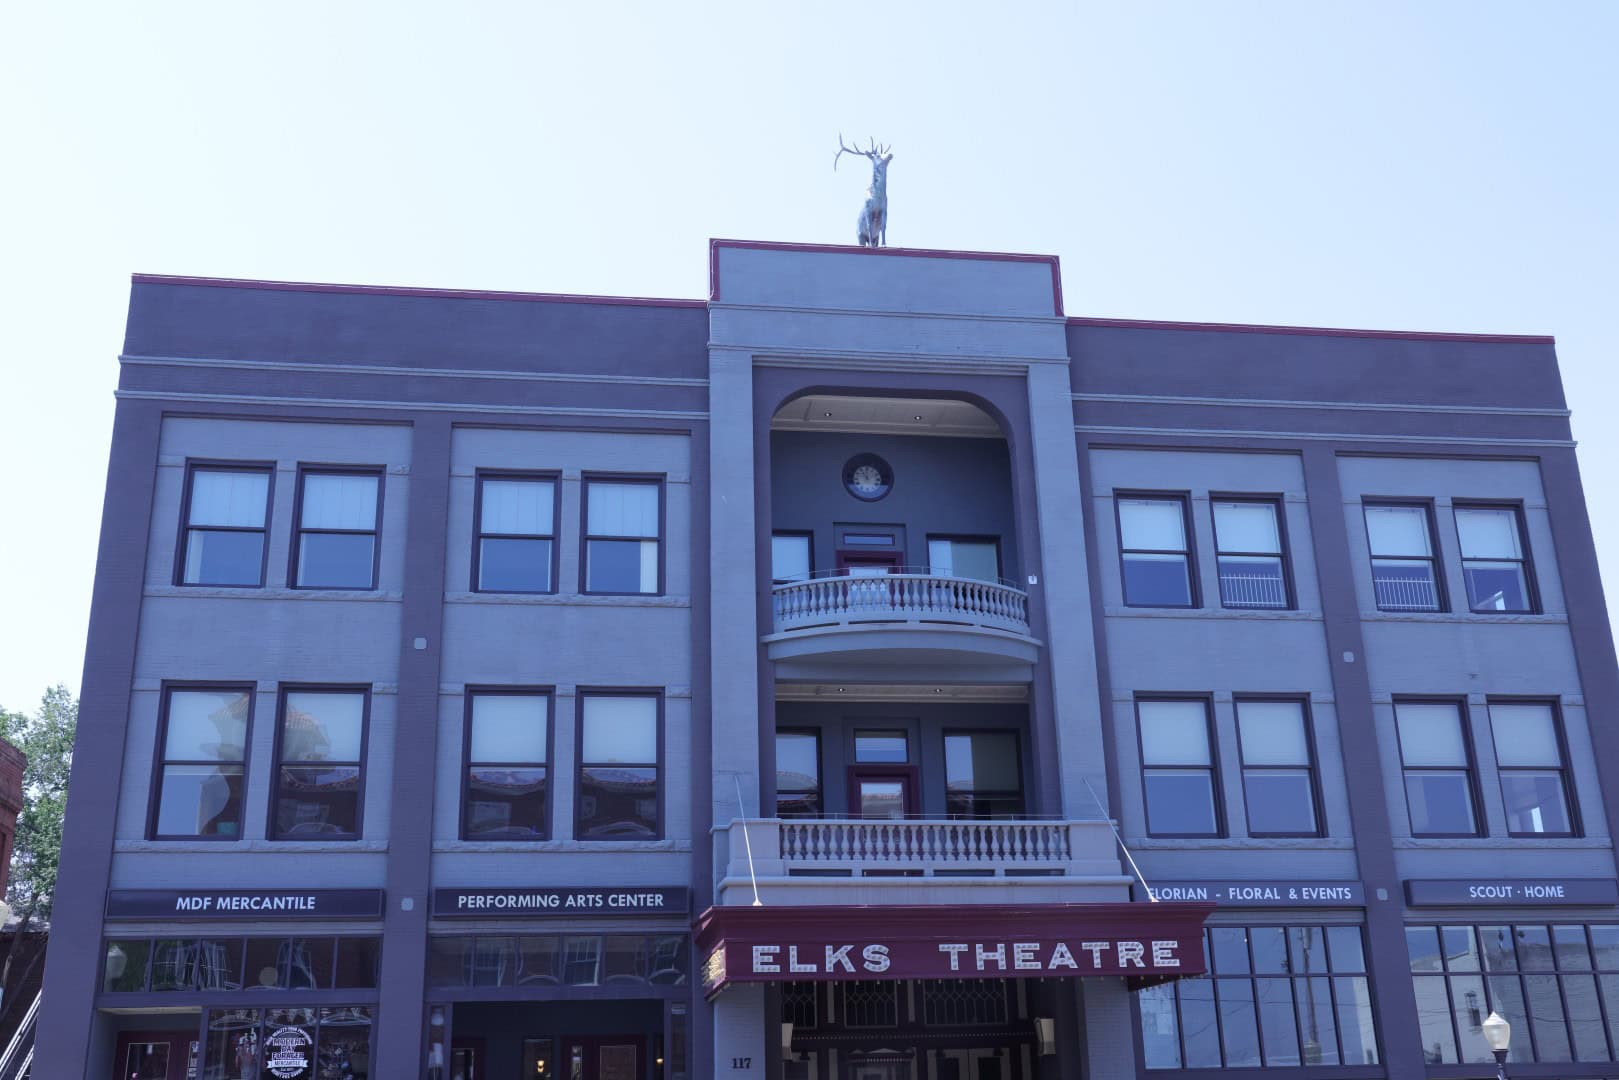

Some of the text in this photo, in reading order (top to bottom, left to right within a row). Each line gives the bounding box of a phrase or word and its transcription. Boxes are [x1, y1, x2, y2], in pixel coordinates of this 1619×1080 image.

[1228, 887, 1281, 900] FLORAL
[1288, 887, 1298, 900] &
[1302, 887, 1352, 900] EVENTS
[1469, 886, 1513, 899] SCOUT
[1524, 886, 1565, 898] HOME
[176, 896, 316, 911] MDF MERCANTILE
[457, 893, 664, 909] PERFORMING ARTS CENTER
[752, 940, 1181, 973] ELKS THEATRE
[732, 1057, 752, 1069] 117
